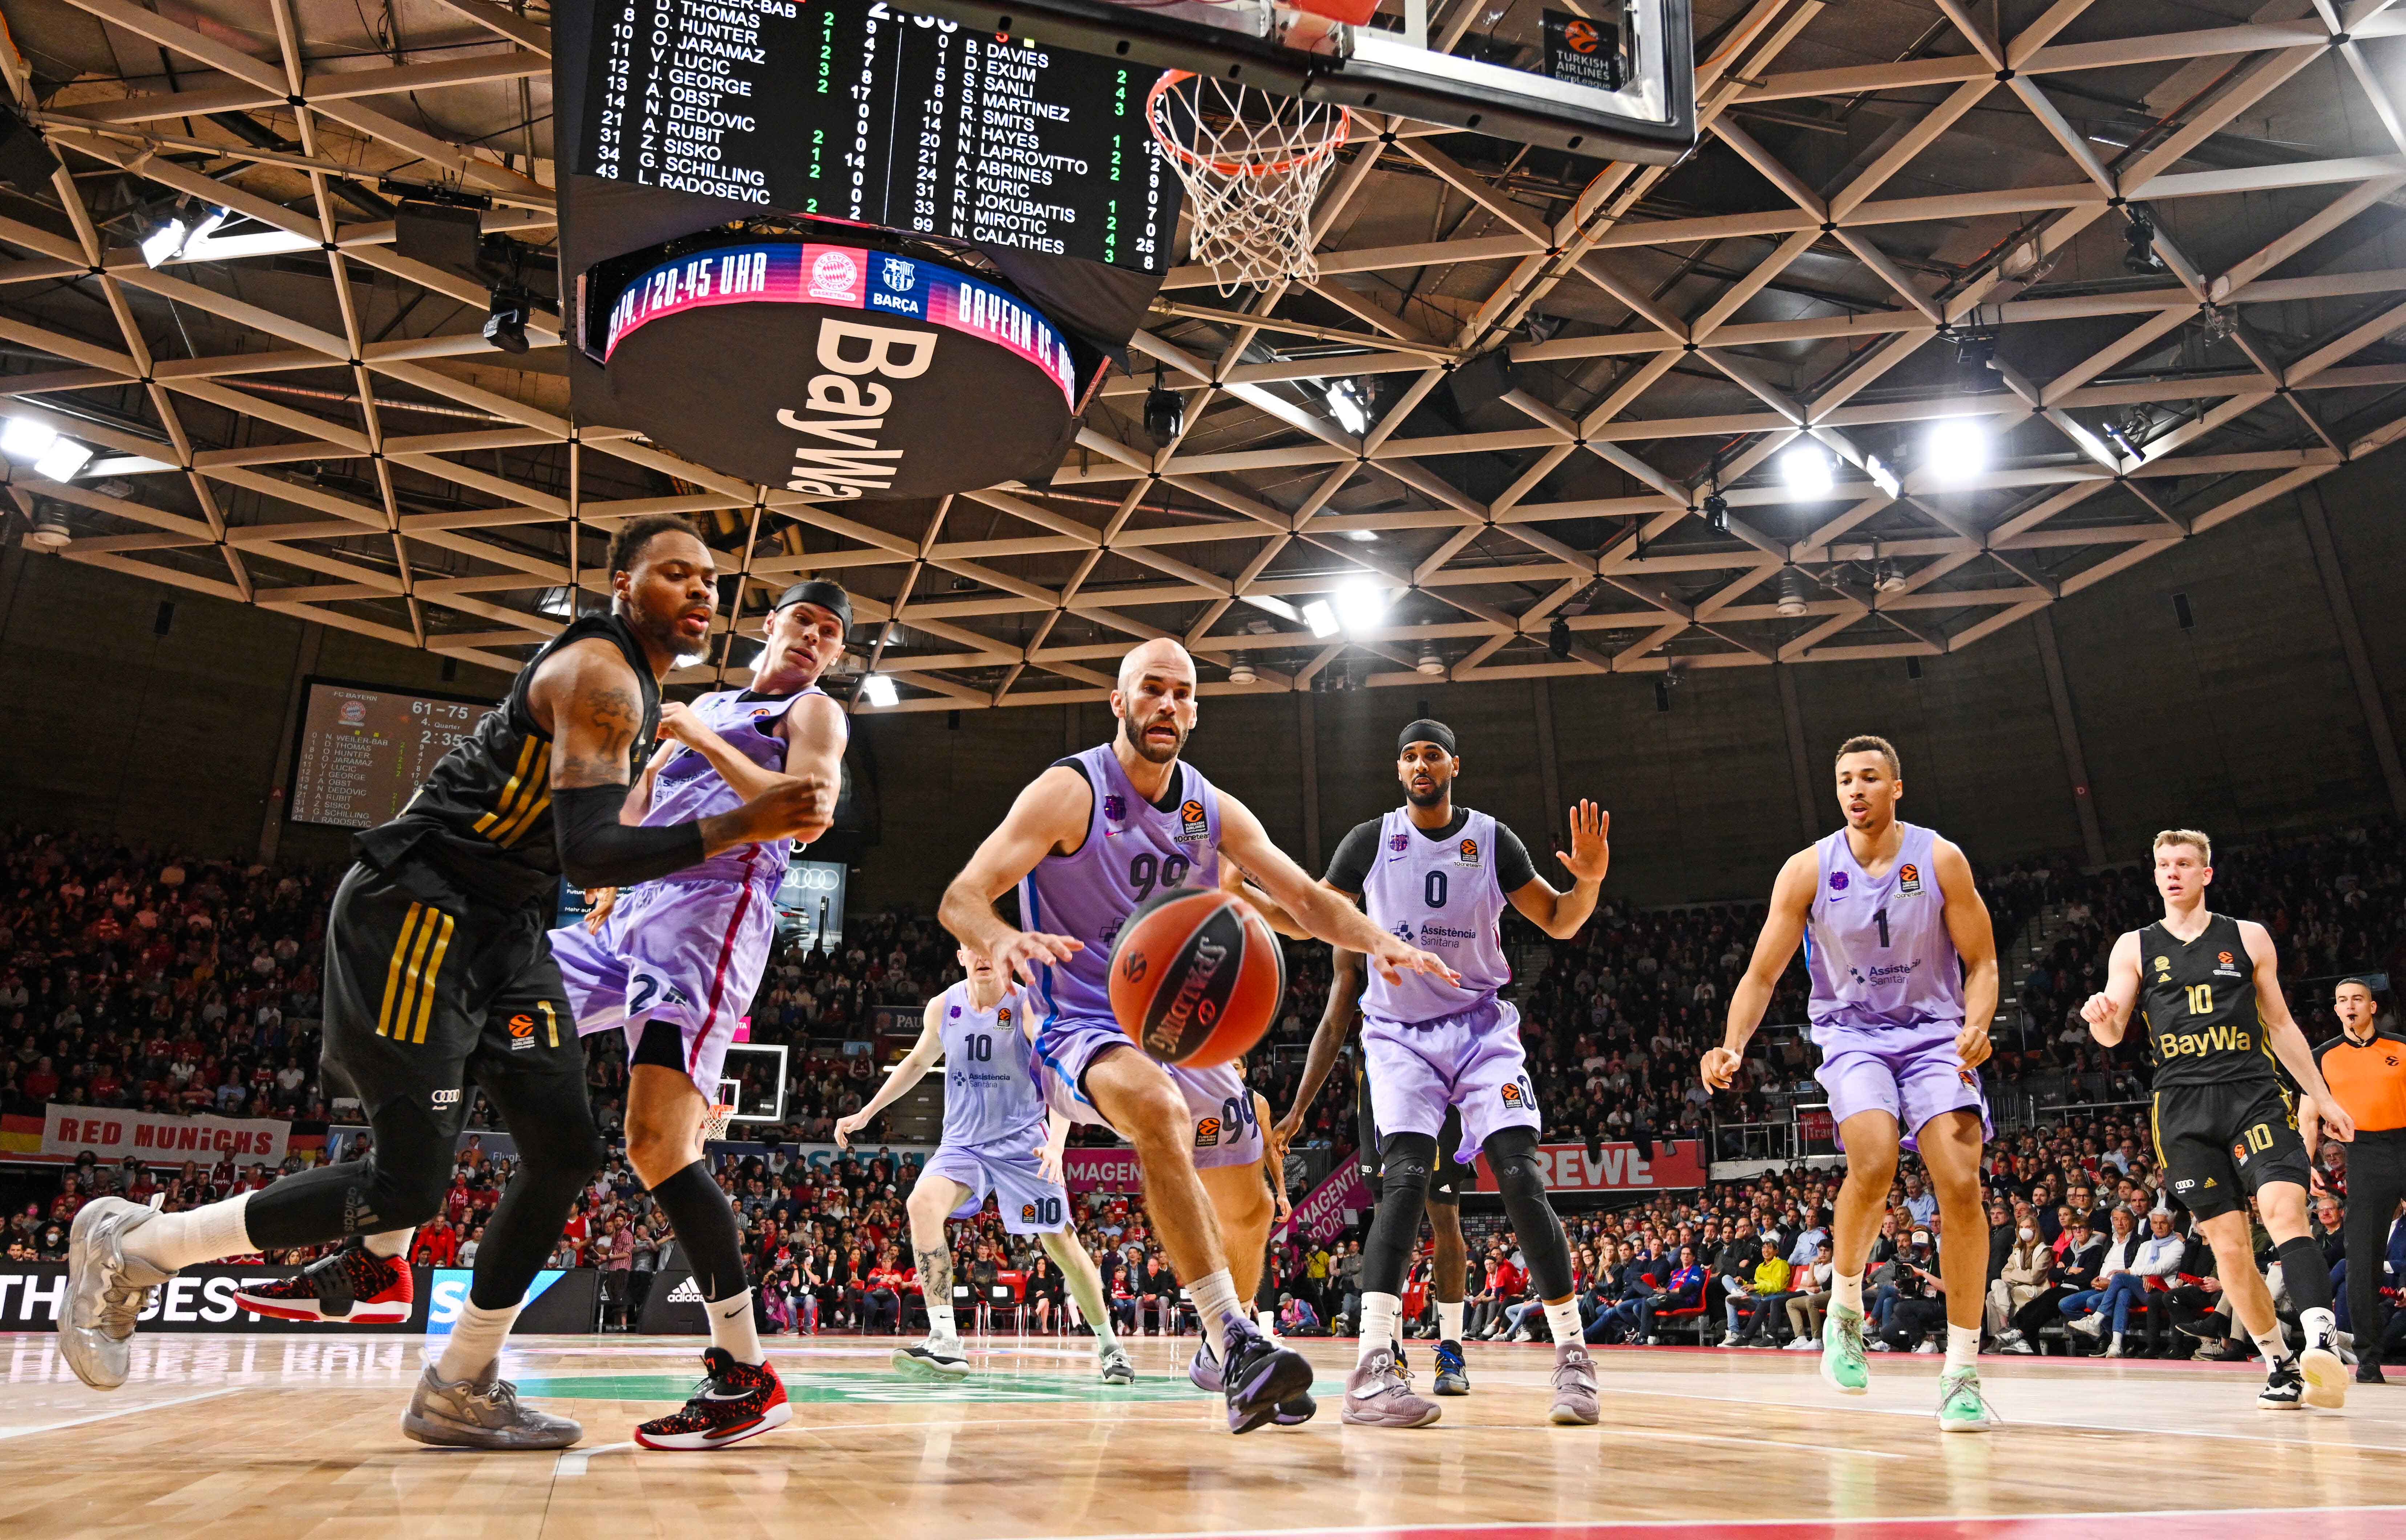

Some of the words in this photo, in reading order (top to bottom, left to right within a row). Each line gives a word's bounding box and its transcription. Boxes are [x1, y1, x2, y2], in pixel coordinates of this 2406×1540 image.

[624, 8, 635, 22] 8
[654, 13, 673, 30] O.
[680, 17, 757, 46] HUNTER
[656, 0, 673, 12] D.
[681, 0, 760, 28] THOMAS
[611, 41, 629, 57] 11
[651, 47, 667, 64] V.
[674, 52, 730, 75] LUCIC
[613, 23, 633, 39] 10
[652, 30, 671, 47] O.
[677, 35, 765, 65] JARAMAZ
[938, 35, 949, 48] 0
[966, 39, 981, 55] B.
[987, 43, 1048, 68] DAVIES
[1556, 50, 1608, 70] TURKISH
[609, 58, 630, 74] 12
[648, 65, 662, 80] J.
[669, 69, 752, 97] GEORGE
[935, 67, 946, 81] 5
[963, 72, 978, 88] S.
[984, 76, 1034, 98] SANLI
[938, 51, 945, 65] 1
[965, 56, 980, 72] D.
[987, 60, 1036, 82] EXUM
[1556, 61, 1609, 81] AIRLINES
[607, 76, 627, 91] 13
[646, 82, 663, 98] A.
[670, 86, 723, 108] OBST
[934, 84, 944, 98] 8
[962, 89, 977, 105] S.
[983, 92, 1070, 122] MARTINEZ
[601, 110, 622, 126] 21
[642, 117, 660, 133] A.
[667, 121, 724, 143] RUBIT
[606, 93, 626, 109] 14
[646, 99, 663, 116] N.
[670, 104, 755, 132] DEDOVIC
[924, 99, 943, 114] 10
[961, 105, 977, 121] R.
[983, 110, 1035, 132] SMITS
[600, 127, 620, 144] 31
[640, 134, 657, 150] Z.
[664, 138, 721, 161] SISKO
[923, 116, 941, 131] 14
[959, 122, 975, 138] N.
[982, 126, 1039, 149] HAYES
[598, 145, 620, 162] 34
[640, 152, 659, 169] G.
[665, 156, 764, 186] SCHILLING
[918, 149, 937, 165] 21
[955, 155, 971, 171] A.
[976, 159, 1052, 185] ABRINES
[920, 132, 940, 148] 20
[958, 138, 974, 154] N.
[980, 142, 1088, 175] LAPROVITTO
[596, 163, 618, 179] 43
[638, 169, 653, 186] L.
[660, 173, 770, 205] RADOSEVIC
[917, 166, 937, 182] 24
[955, 172, 970, 188] K.
[976, 176, 1030, 198] KURIC
[914, 199, 934, 215] 33
[953, 205, 969, 222] N.
[975, 209, 1047, 235] MIROTIC
[916, 182, 934, 198] 31
[954, 189, 970, 205] R.
[975, 193, 1075, 223] JOKUBAITIS
[913, 216, 933, 232] 99
[951, 222, 967, 239] N.
[973, 226, 1064, 255] CALATHES
[818, 259, 825, 268] FC
[827, 255, 852, 272] BAYERN
[652, 258, 713, 311] 20:45
[719, 253, 767, 295] UHR
[813, 290, 852, 300] BASKETBALL
[873, 293, 919, 313] BARÇA
[959, 282, 1031, 352] BAYERN
[776, 317, 938, 498] BayWa
[346, 693, 377, 701] BAYERN
[333, 757, 373, 766] JARAMAZ
[334, 749, 370, 759] HUNTER
[336, 742, 371, 751] THOMAS
[329, 771, 366, 781] GEORGE
[331, 764, 356, 772] LUCIC
[324, 802, 351, 810] SISKO
[328, 787, 367, 796] DEDOVIC
[322, 816, 372, 827] RADOSEVIC
[324, 809, 369, 819] SCHILLING
[1130, 853, 1189, 902] 99
[1424, 870, 1447, 908] 0
[1421, 924, 1476, 939] Assistència
[1421, 936, 1459, 948] Sanitària
[1873, 908, 1889, 948] 1
[1145, 936, 1227, 1054] SPALDING
[2185, 984, 2213, 1015] 10
[537, 1000, 560, 1048] 1
[965, 1033, 992, 1062] 10
[2159, 1026, 2251, 1059] BayWa
[1517, 1075, 1536, 1111] 0
[58, 1118, 122, 1146] RED
[2244, 1123, 2274, 1155] 10
[1535, 1148, 1654, 1186] REWE
[1034, 1197, 1061, 1224] 10
[667, 1292, 705, 1302] adidas
